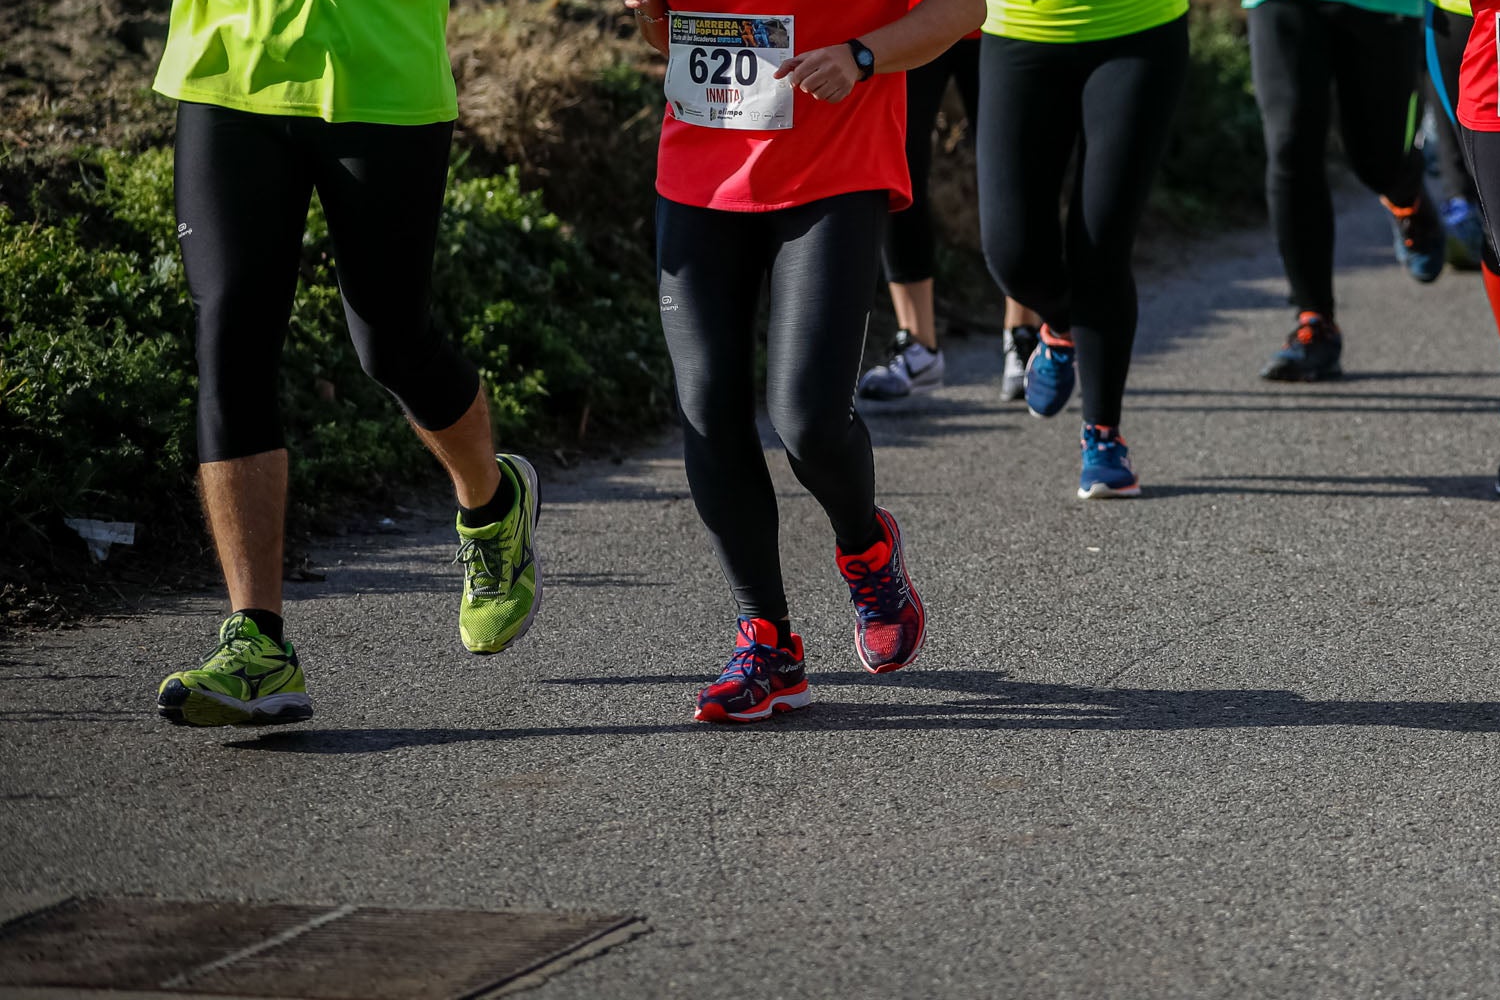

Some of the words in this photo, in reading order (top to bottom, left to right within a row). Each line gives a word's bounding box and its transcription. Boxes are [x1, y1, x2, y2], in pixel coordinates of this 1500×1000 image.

[696, 20, 739, 29] CARRERA
[696, 28, 739, 36] POPULAR
[689, 47, 758, 86] 620
[706, 88, 740, 104] INMITA
[718, 108, 743, 117] olimpo
